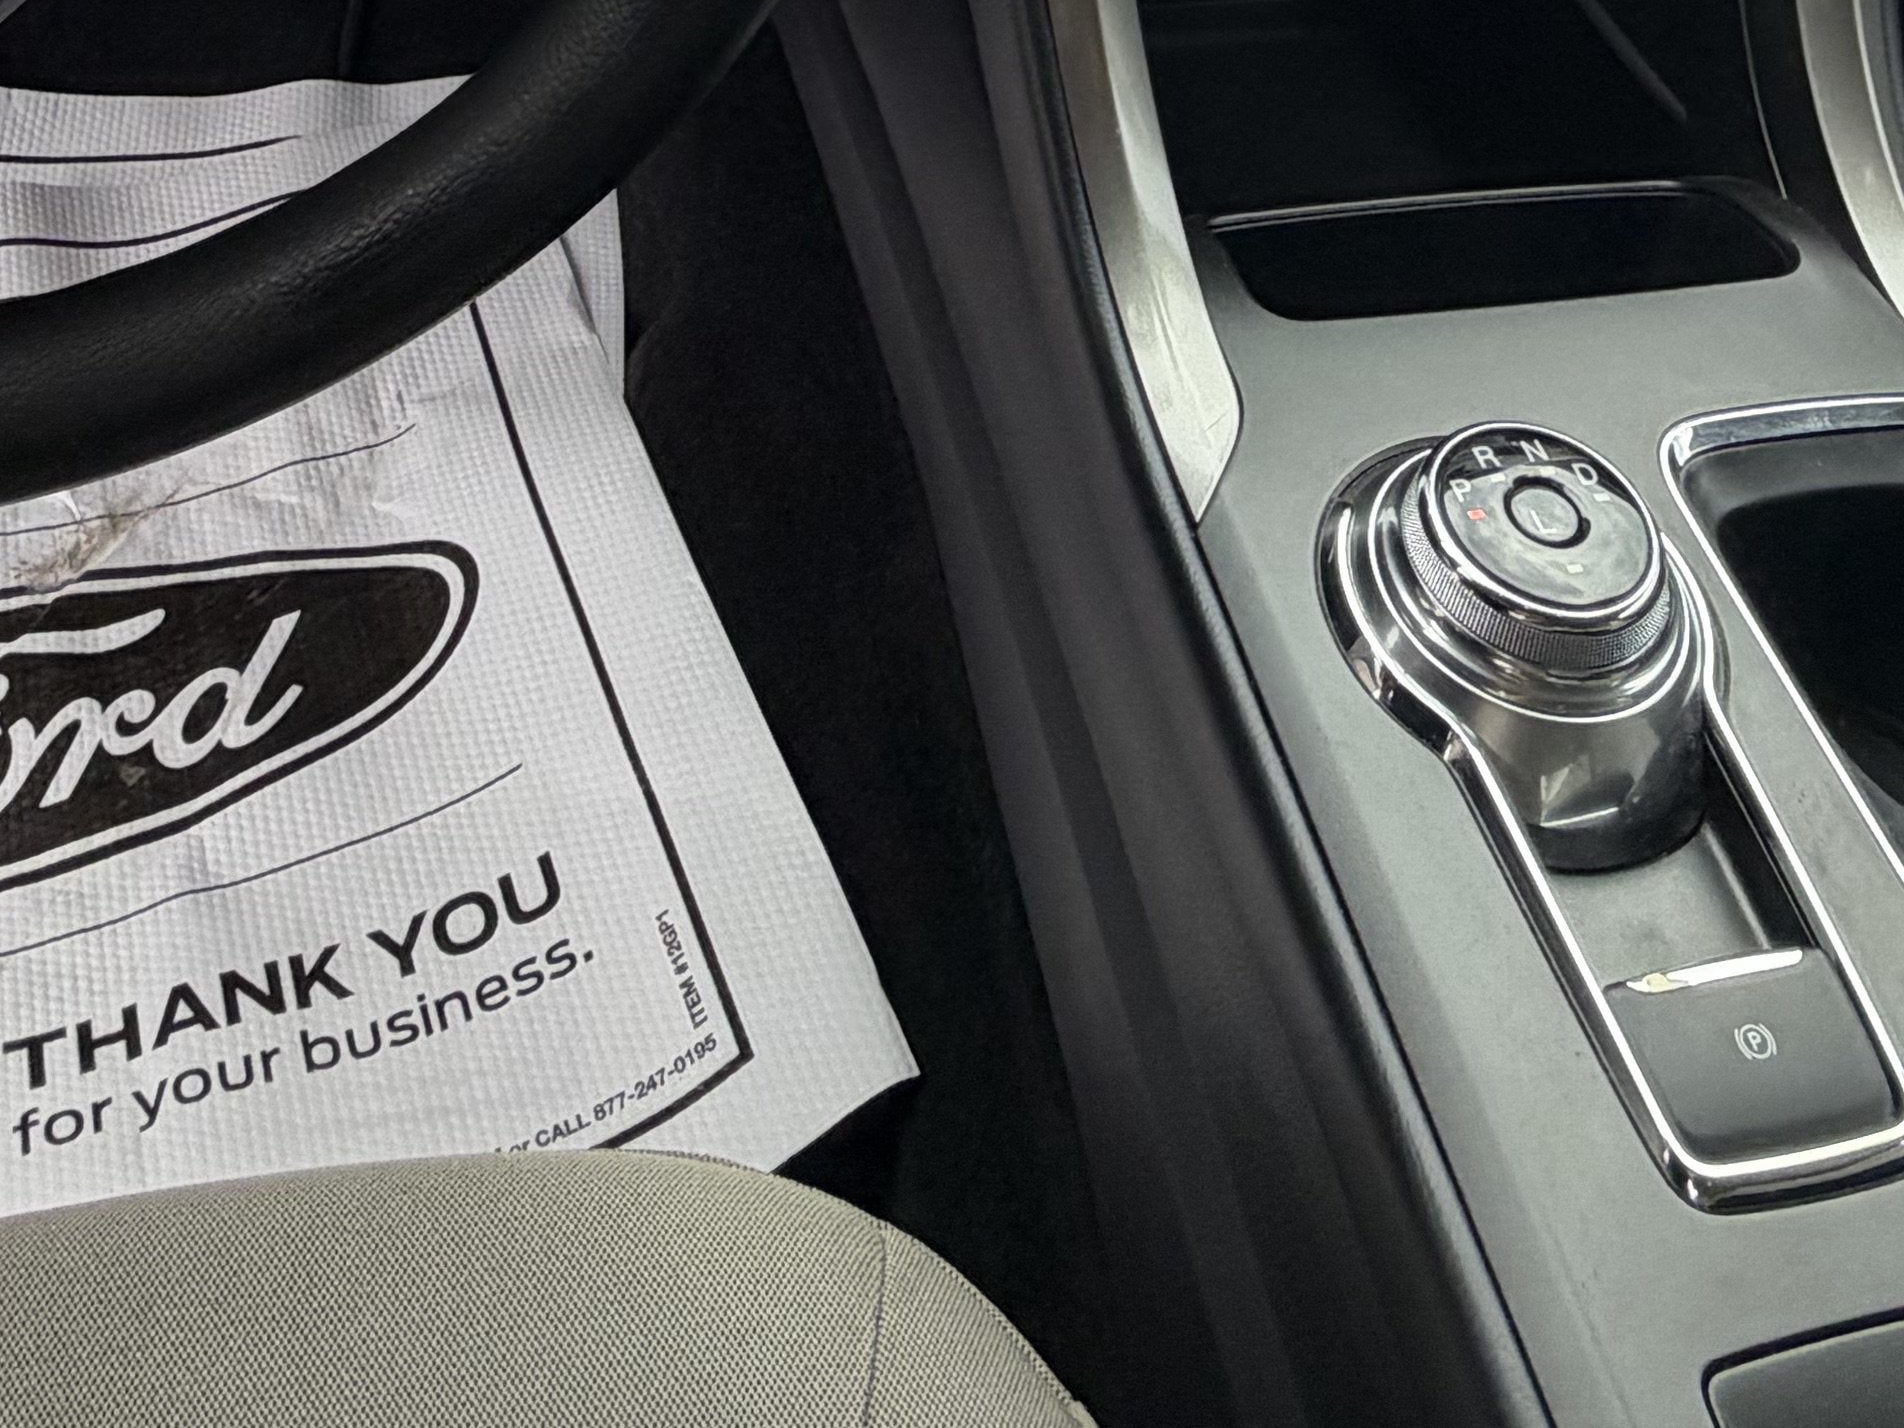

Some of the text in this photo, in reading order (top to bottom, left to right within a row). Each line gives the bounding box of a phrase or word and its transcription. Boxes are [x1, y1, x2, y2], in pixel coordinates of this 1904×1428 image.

[1472, 446, 1502, 469] R
[1519, 439, 1549, 462] N
[1571, 463, 1598, 485] D
[1449, 479, 1472, 502] P
[1530, 510, 1558, 533] L
[3, 851, 564, 1090] THANK YOU
[678, 975, 709, 1030] ITEM
[11, 937, 595, 1156] for your business.
[534, 1114, 592, 1148] CALL
[593, 1033, 718, 1122] 877-247-0195
